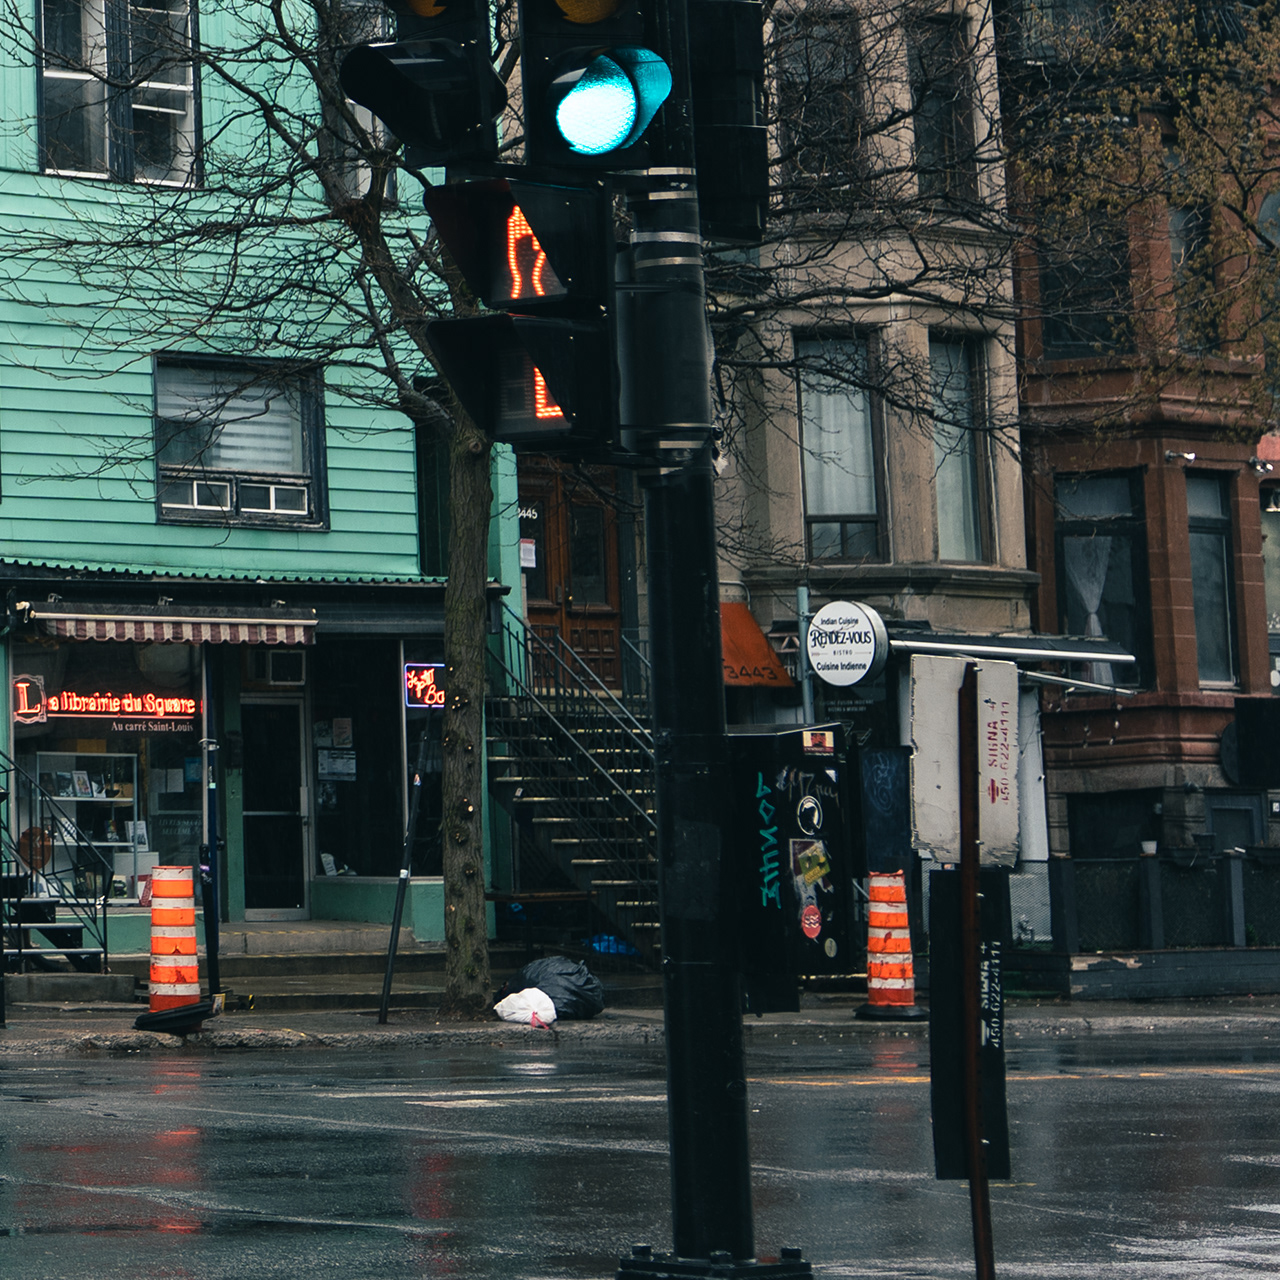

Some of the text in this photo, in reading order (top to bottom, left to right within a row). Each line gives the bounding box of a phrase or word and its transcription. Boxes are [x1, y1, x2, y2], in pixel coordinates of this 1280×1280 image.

[838, 617, 859, 625] Cuisine
[724, 666, 778, 680] 3443
[816, 662, 867, 671] Cuisine Indienne
[61, 691, 121, 712] librairie
[123, 693, 142, 711] du
[143, 693, 196, 717] Square
[424, 684, 445, 704] Ba
[111, 721, 193, 732] Au carré Saint-Louis
[987, 721, 999, 768] SIGNA
[1000, 701, 1010, 805] 450-622-4111
[990, 941, 1001, 1048] 450-622-4111
